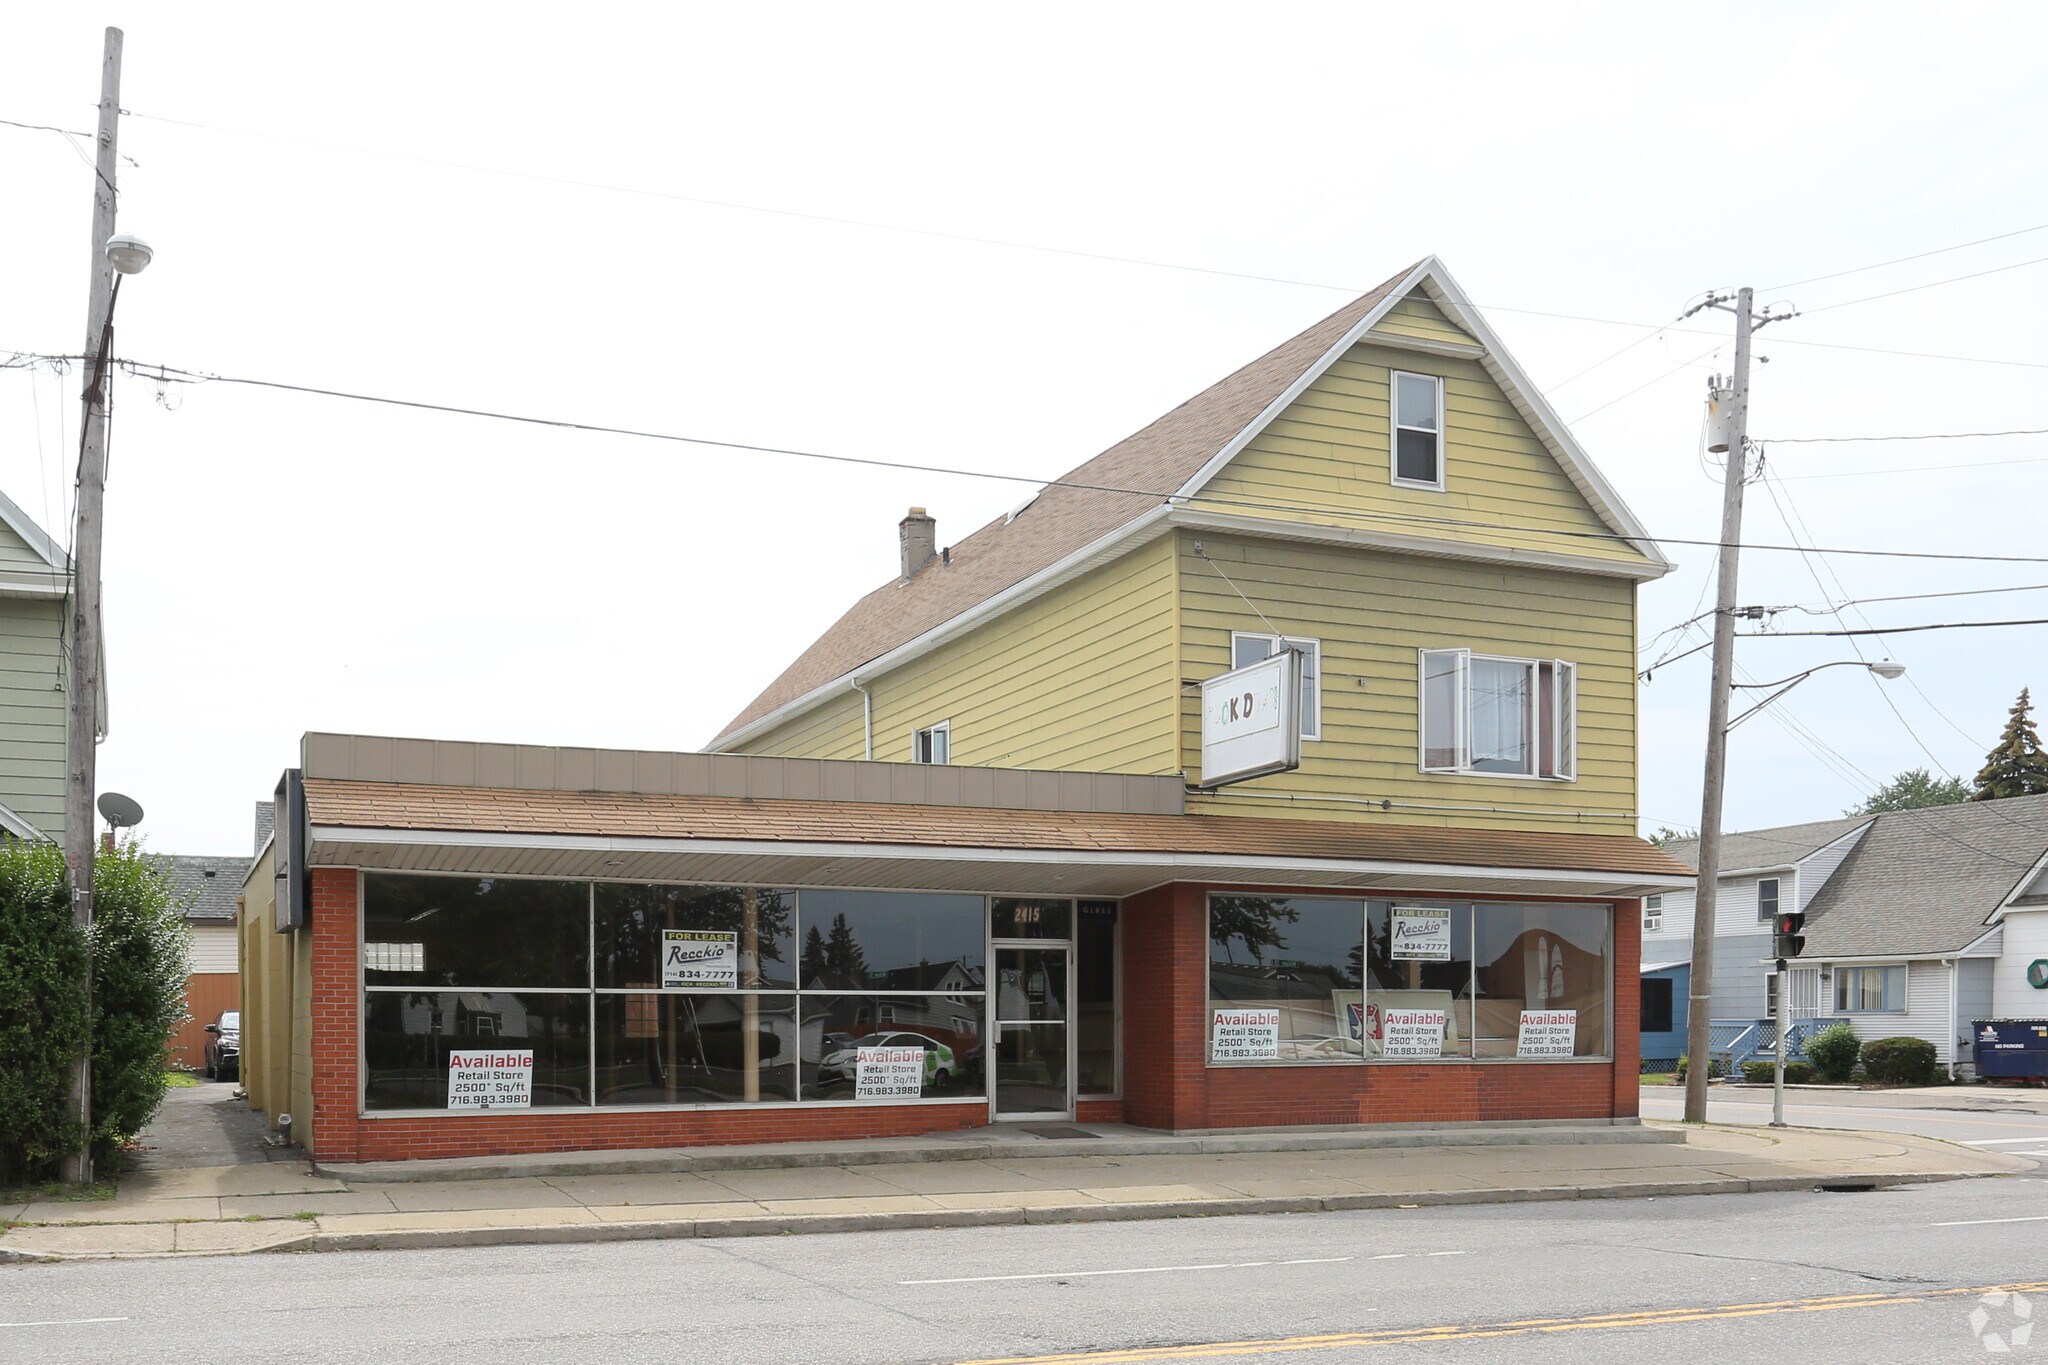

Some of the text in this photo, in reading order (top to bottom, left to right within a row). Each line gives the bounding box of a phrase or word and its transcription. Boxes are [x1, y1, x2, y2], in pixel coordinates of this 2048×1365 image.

[1014, 907, 1040, 922] 2415
[1418, 910, 1446, 918] LEASE
[1395, 920, 1440, 939] Recckio
[668, 932, 731, 941] FOR LEASE
[667, 944, 724, 966] Recckio
[678, 970, 734, 978] 834-7777
[1214, 1013, 1278, 1025] Available
[1386, 1013, 1444, 1024] Available
[1520, 1014, 1576, 1025] Available
[1220, 1028, 1272, 1036] Retail Store
[1250, 1038, 1272, 1047] Sq/ft
[1417, 1037, 1438, 1046] Sq/ft
[1550, 1037, 1570, 1045] Sq/ft
[1214, 1049, 1276, 1057] 716.983.3980
[1519, 1046, 1572, 1054] 716.983.3980
[857, 1050, 923, 1062] Available
[450, 1054, 532, 1068] Available
[458, 1071, 523, 1080] Retail Store
[893, 1075, 917, 1085] Sq/ft
[496, 1082, 525, 1093] Sq/ft
[857, 1087, 919, 1095] 716.983.3980
[450, 1095, 528, 1104] 716.983.3980
